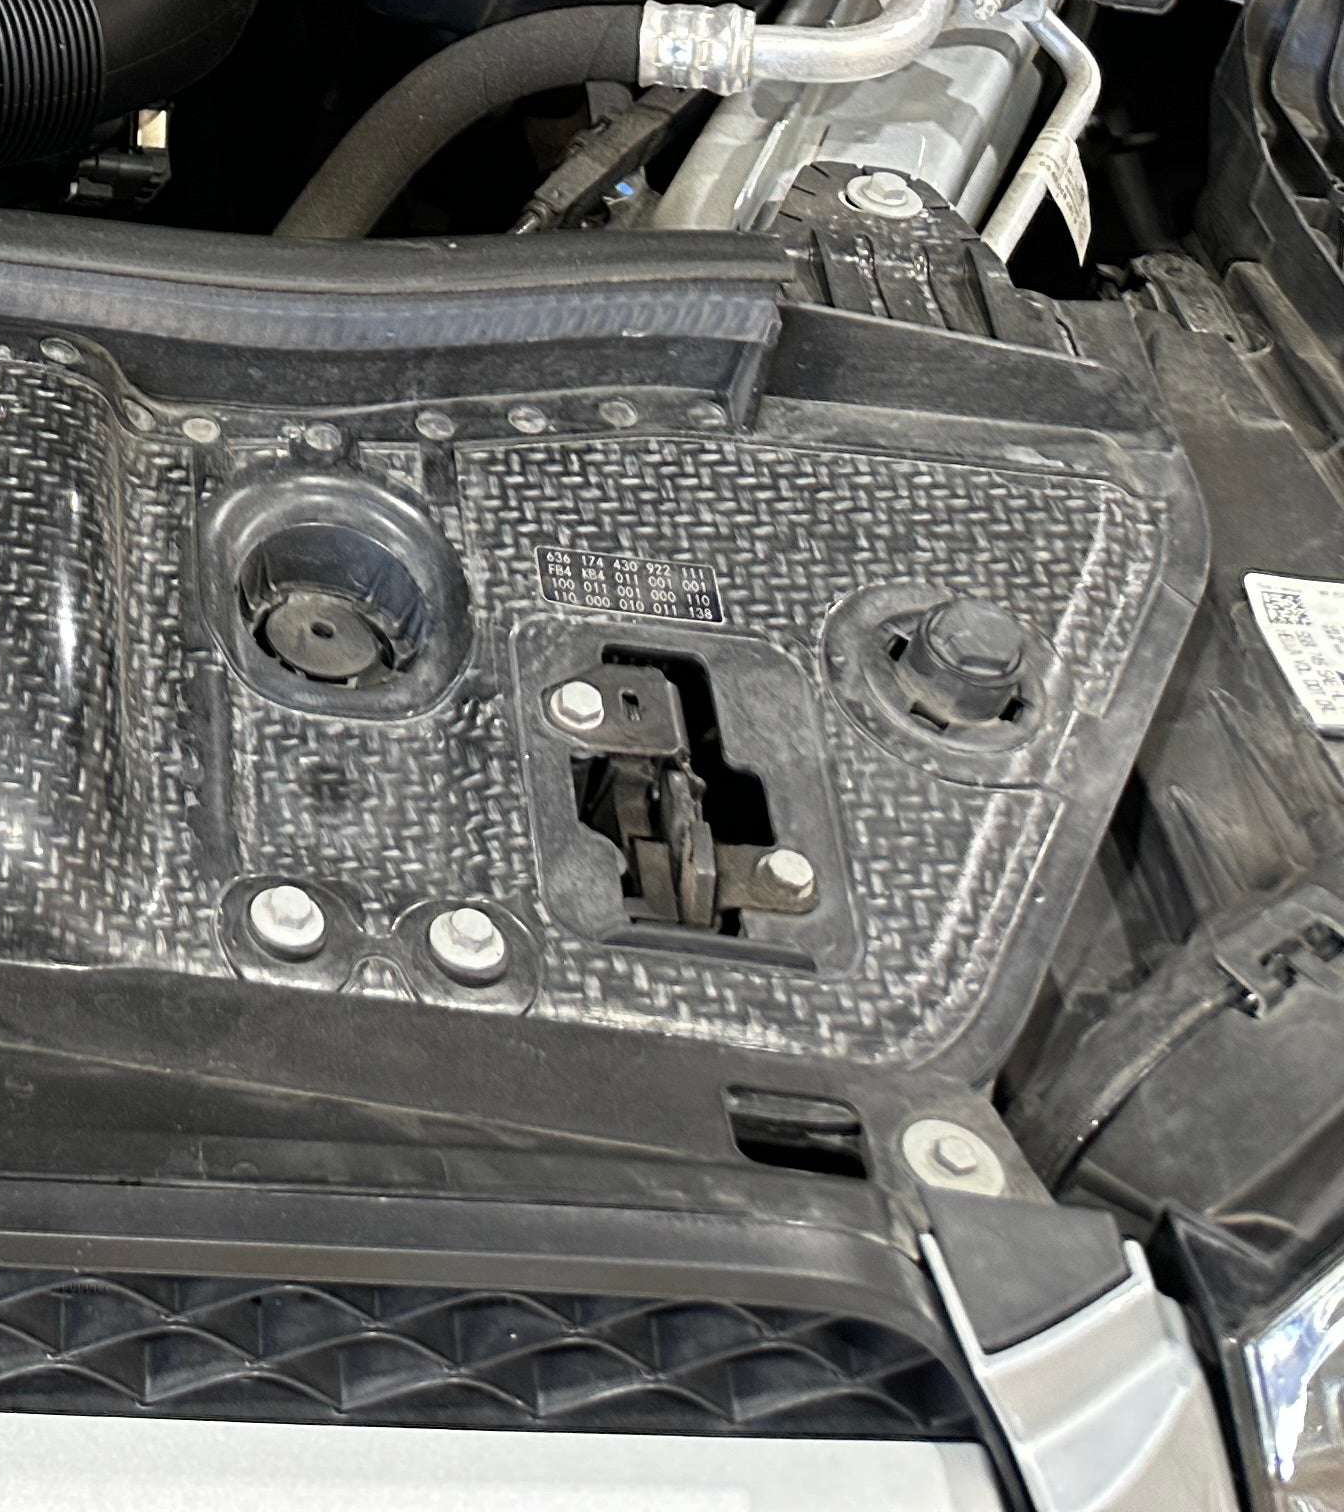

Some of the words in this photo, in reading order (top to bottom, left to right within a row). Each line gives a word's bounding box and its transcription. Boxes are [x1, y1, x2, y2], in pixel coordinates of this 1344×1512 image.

[546, 551, 571, 564] 636
[581, 555, 604, 568] 174
[613, 559, 638, 572] 430
[646, 563, 671, 576] 922
[682, 568, 704, 579] 111
[549, 564, 572, 577] FB4
[615, 572, 639, 584] 011
[648, 576, 673, 589] 001
[682, 580, 706, 592] 001
[552, 578, 575, 590] 100
[584, 582, 607, 594] 011
[617, 586, 641, 599] 001
[651, 590, 676, 603] 000
[687, 594, 710, 607] 110
[554, 591, 577, 603] 110
[586, 595, 610, 608] 000
[620, 599, 644, 612] 010
[653, 603, 677, 616] 011
[689, 607, 713, 620] 138
